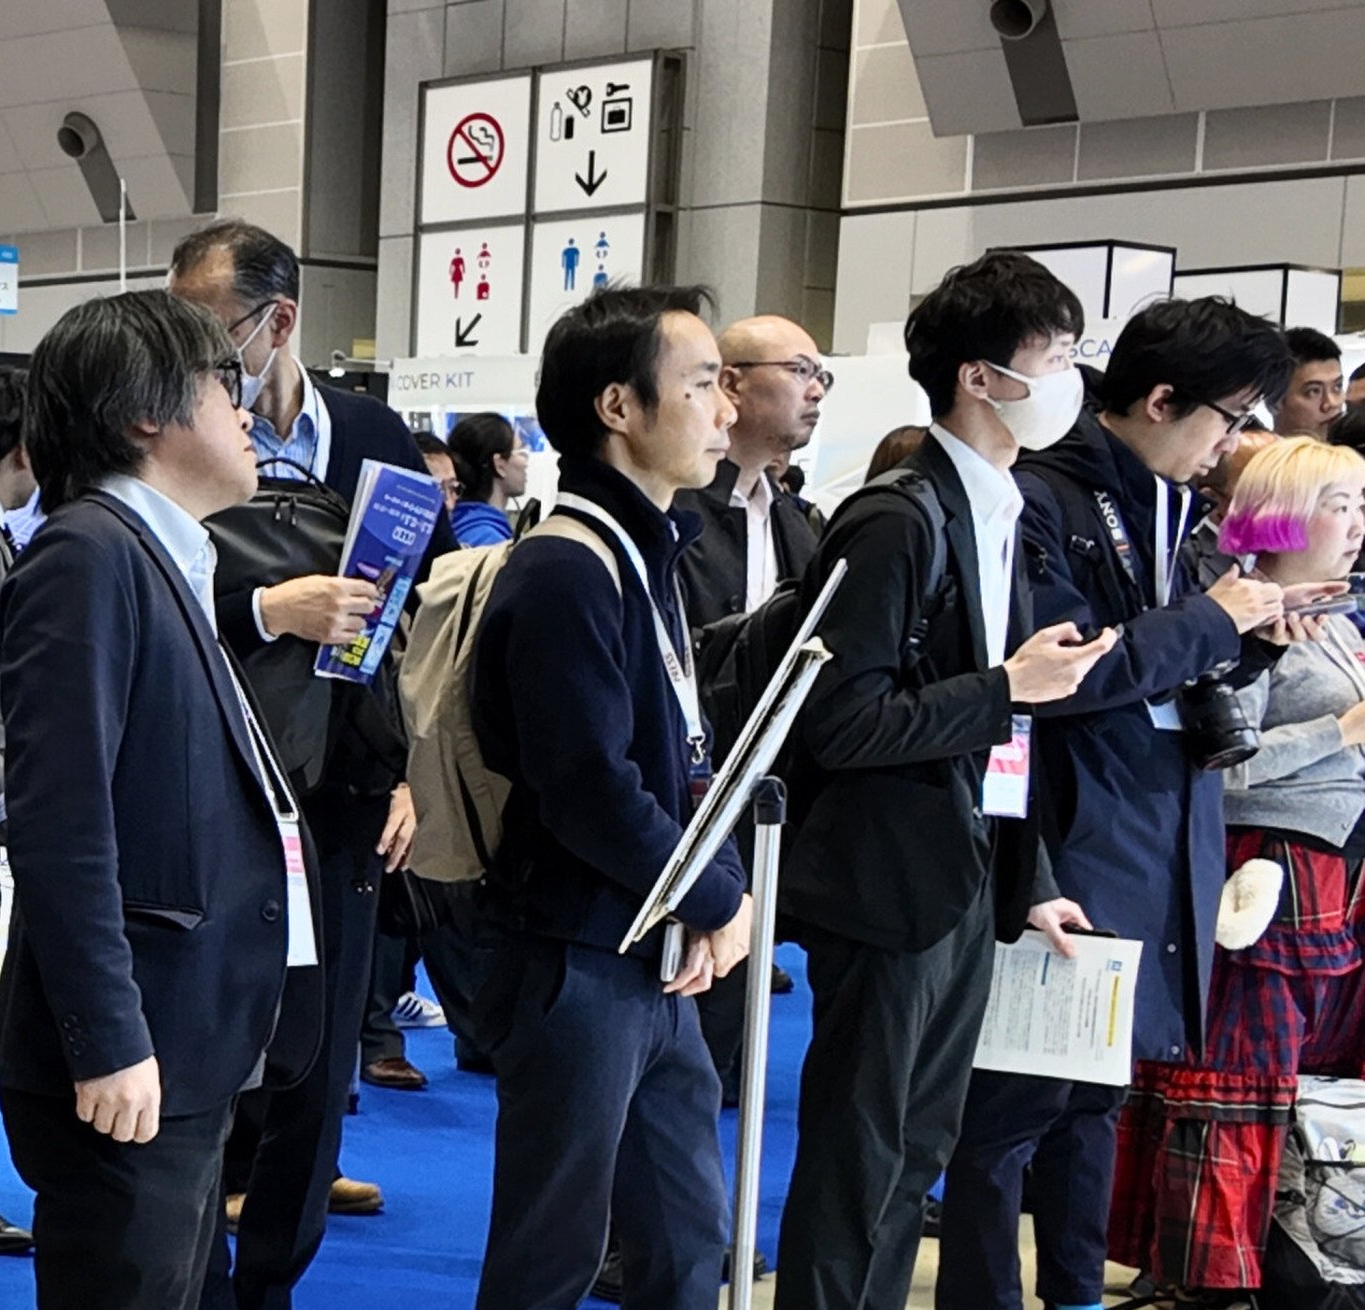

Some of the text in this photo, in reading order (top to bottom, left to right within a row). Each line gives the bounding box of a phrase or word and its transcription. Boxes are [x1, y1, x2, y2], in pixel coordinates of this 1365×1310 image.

[446, 372, 474, 388] KIT
[1094, 490, 1122, 540] SONY
[665, 651, 680, 682] PRESS
